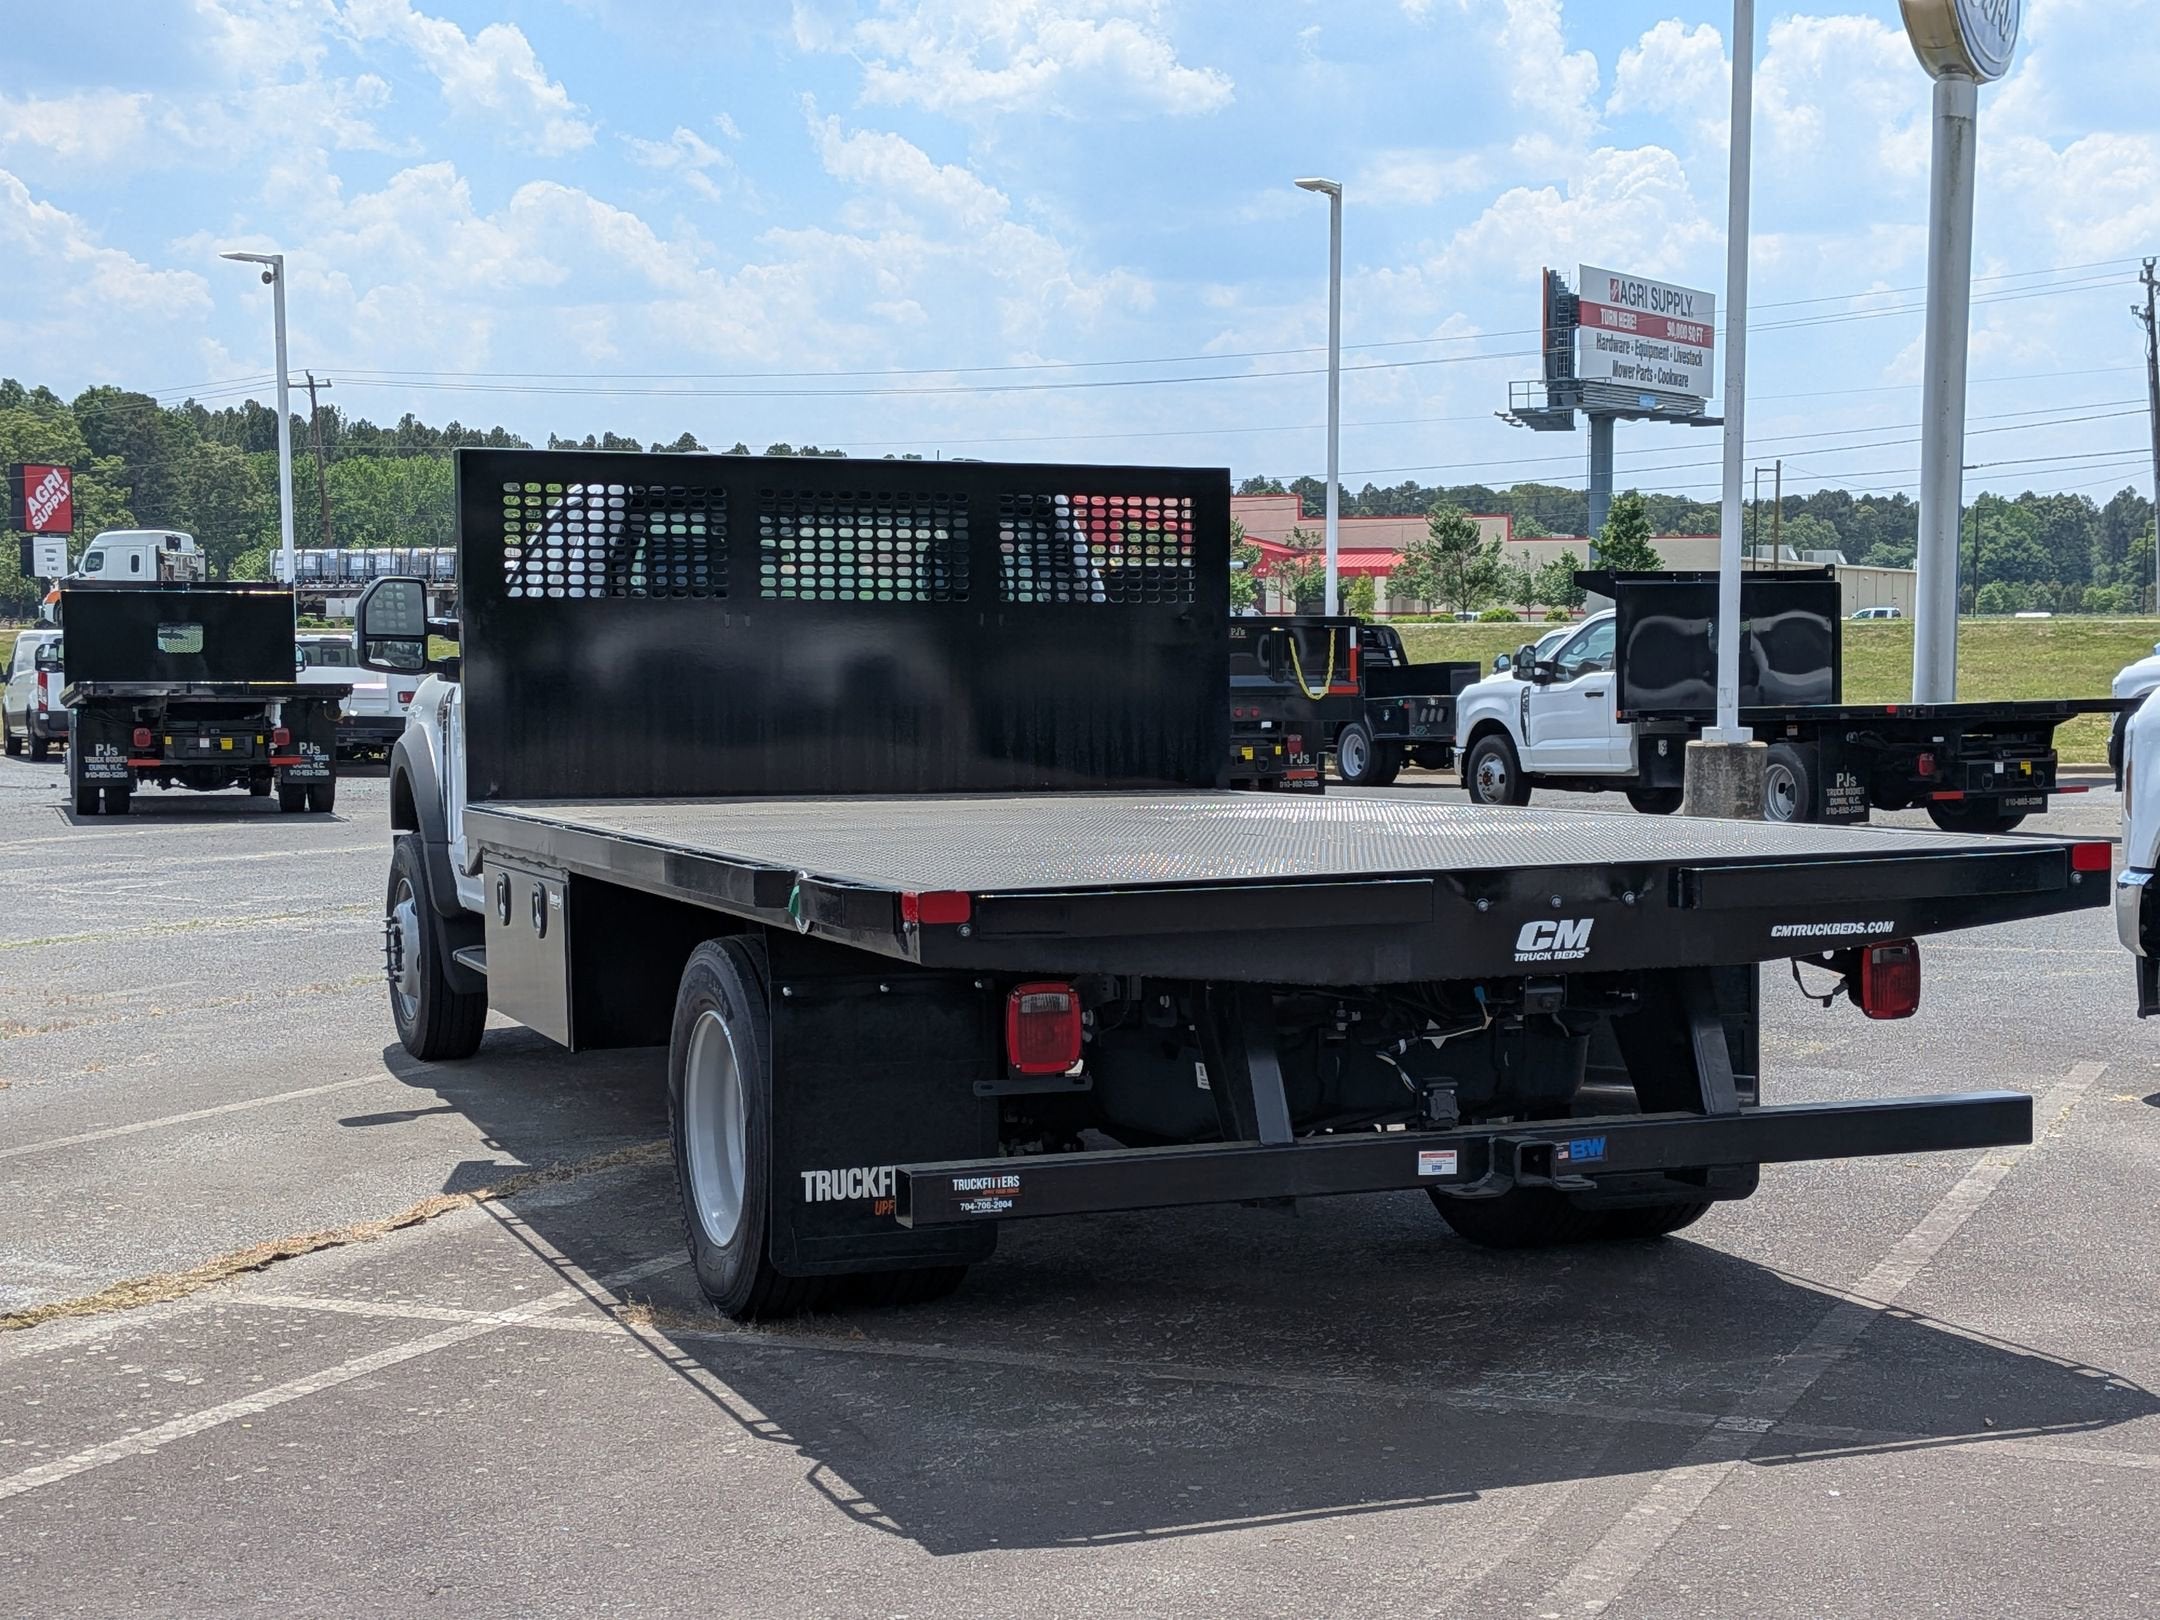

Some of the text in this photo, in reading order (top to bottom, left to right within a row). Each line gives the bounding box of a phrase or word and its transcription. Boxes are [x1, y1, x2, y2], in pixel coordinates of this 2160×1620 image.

[1620, 280, 1648, 308] AGRI
[1600, 308, 1618, 327] TURN
[1696, 326, 1704, 343] FT
[1596, 332, 1703, 367] Hardware Equipment Livestock
[1612, 360, 1689, 388] Mower Parts Cookware
[27, 468, 64, 516] AGRI
[32, 481, 71, 530] SUPPLY
[95, 743, 119, 756] PJs
[1836, 772, 1857, 788] PJs
[1516, 918, 1594, 952] CM
[1770, 920, 1895, 938] CMTRUCKBEDS.COM
[1514, 950, 1553, 962] TRUCK
[952, 1175, 1020, 1191] TRUCKFITTERS
